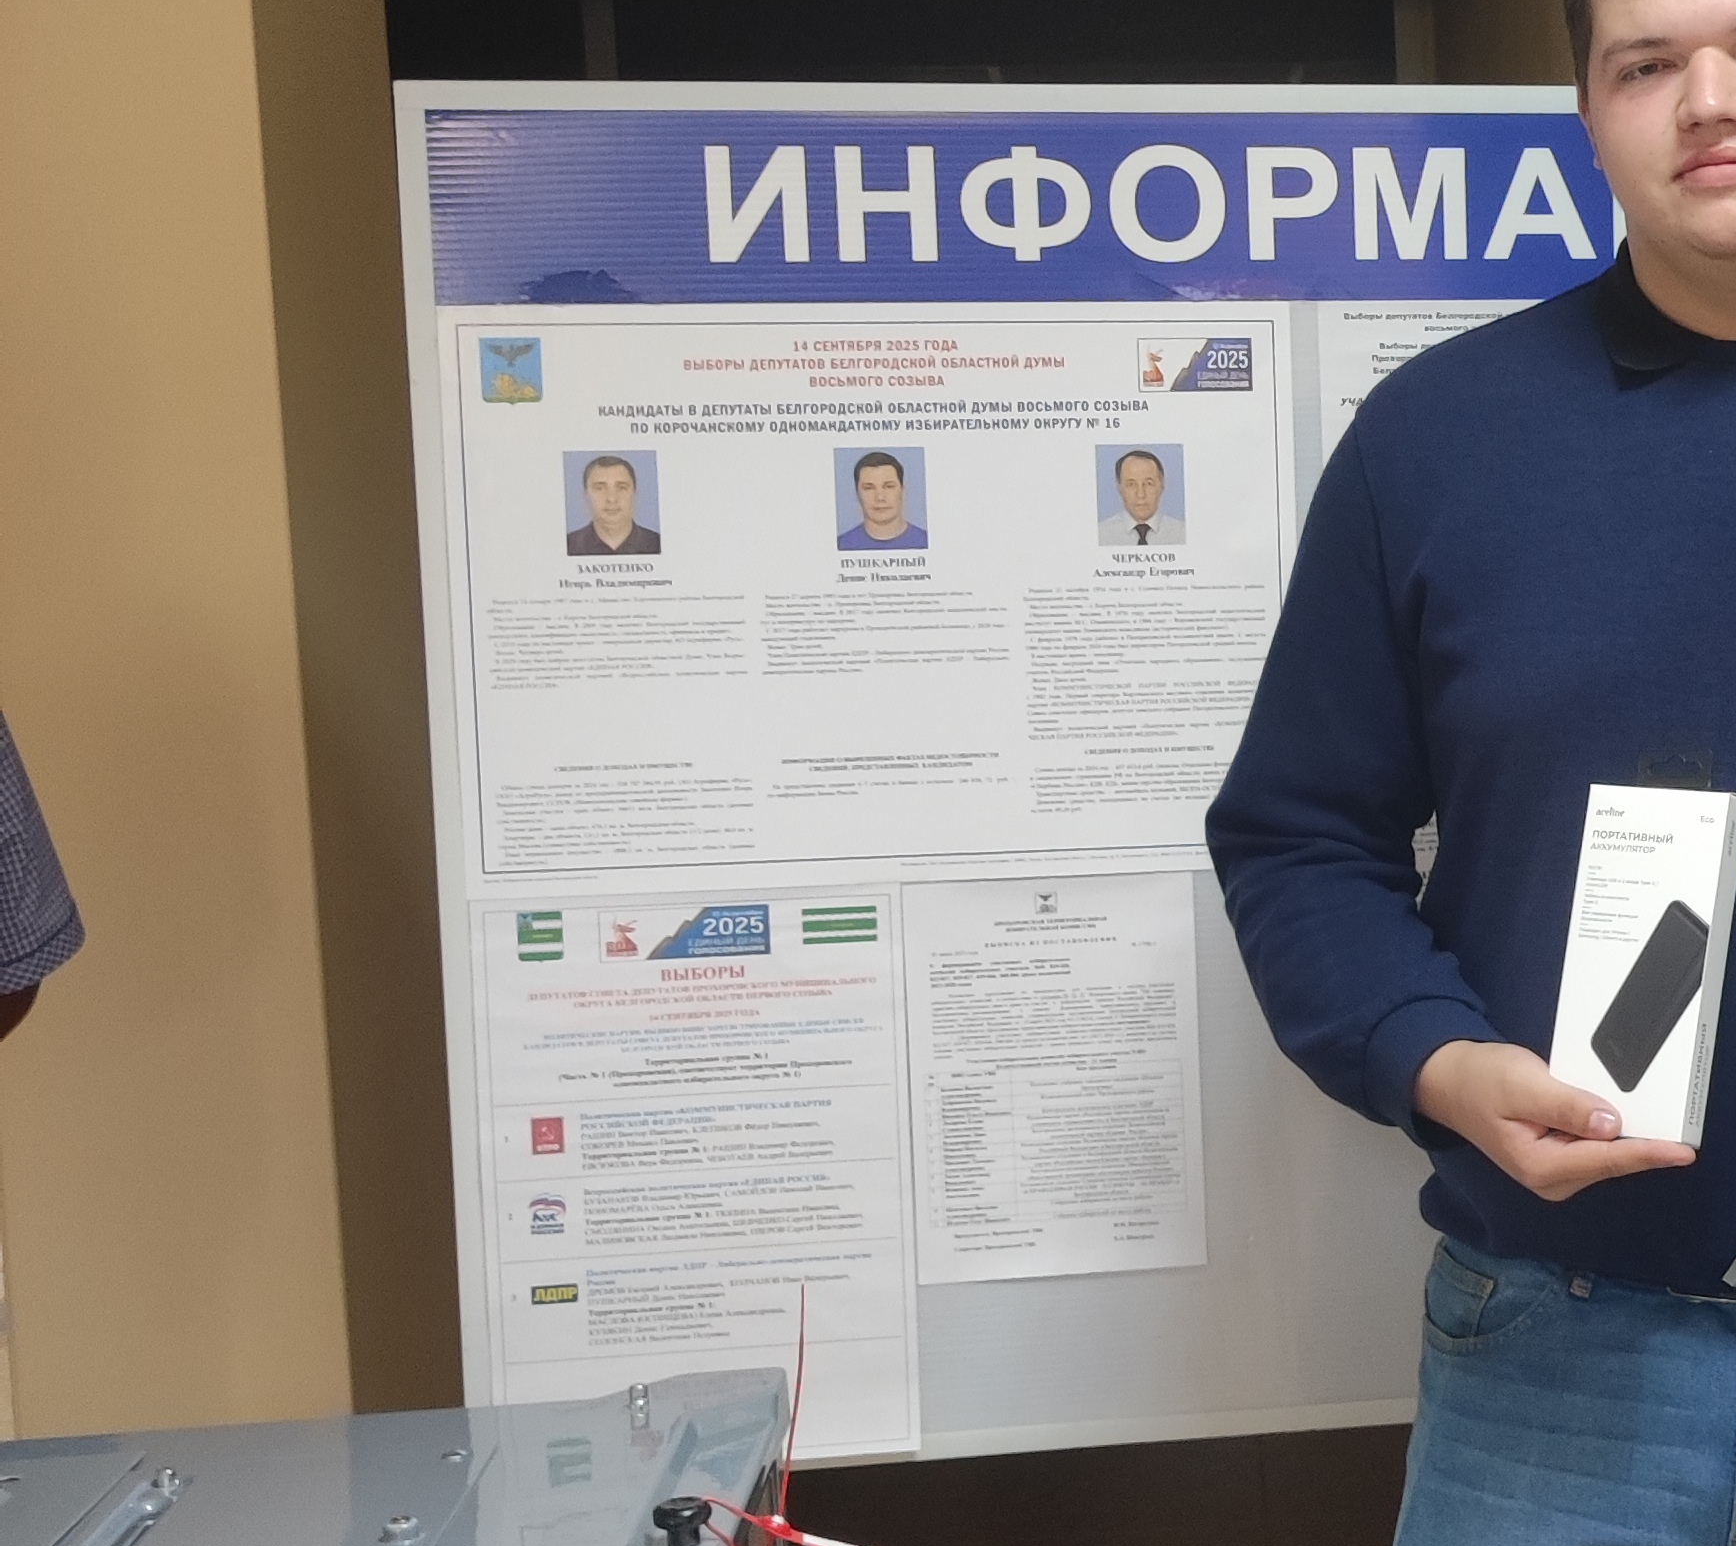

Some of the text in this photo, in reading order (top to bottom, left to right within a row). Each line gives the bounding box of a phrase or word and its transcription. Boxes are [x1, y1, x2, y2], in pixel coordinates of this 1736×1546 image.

[793, 339, 958, 353] 14 СЕНТЯБРЯ 2025 ГОДА
[683, 355, 1066, 372] ВЫБОРЫ ДЕПУТАТОВ БЕЛГОРОДСКОЙ ОБЛАСТНОЙ ДУМЫ
[1206, 350, 1250, 369] 2025
[809, 375, 945, 388] ВОСЬМОГО СОЗЫВА
[599, 399, 1149, 418] КАНДИДАТЫ В ДЕПУТАТЫ БЕЛГОРОДСКОЙ ОБЛАСТНОЙ ДУМЫ ВОСЬМОГО СОЗЫВА
[630, 422, 649, 434] ПО
[653, 421, 766, 434] КОРОЧАНСКОМУ
[769, 419, 902, 434] ОДНОМАНДАТНОМУ
[905, 418, 1030, 431] ИЗБИРАТЕЛЬНОМУ
[1034, 418, 1082, 430] ОКРУГУ
[1105, 417, 1121, 429] 16
[840, 556, 927, 569] ПУШКАРНЫЙ
[1111, 552, 1176, 563] ЧЕРКАСОВ
[577, 562, 655, 574] ЗАКОТЕНКО
[1700, 815, 1716, 824] Eco
[1591, 829, 1674, 845] ПОРТАТИВНЫЙ
[1590, 841, 1656, 854] АККУМУЛЯТОР
[702, 916, 765, 937] 2025
[660, 964, 746, 982] ВЫБОРЫ
[532, 1287, 579, 1303] ЛДПР
